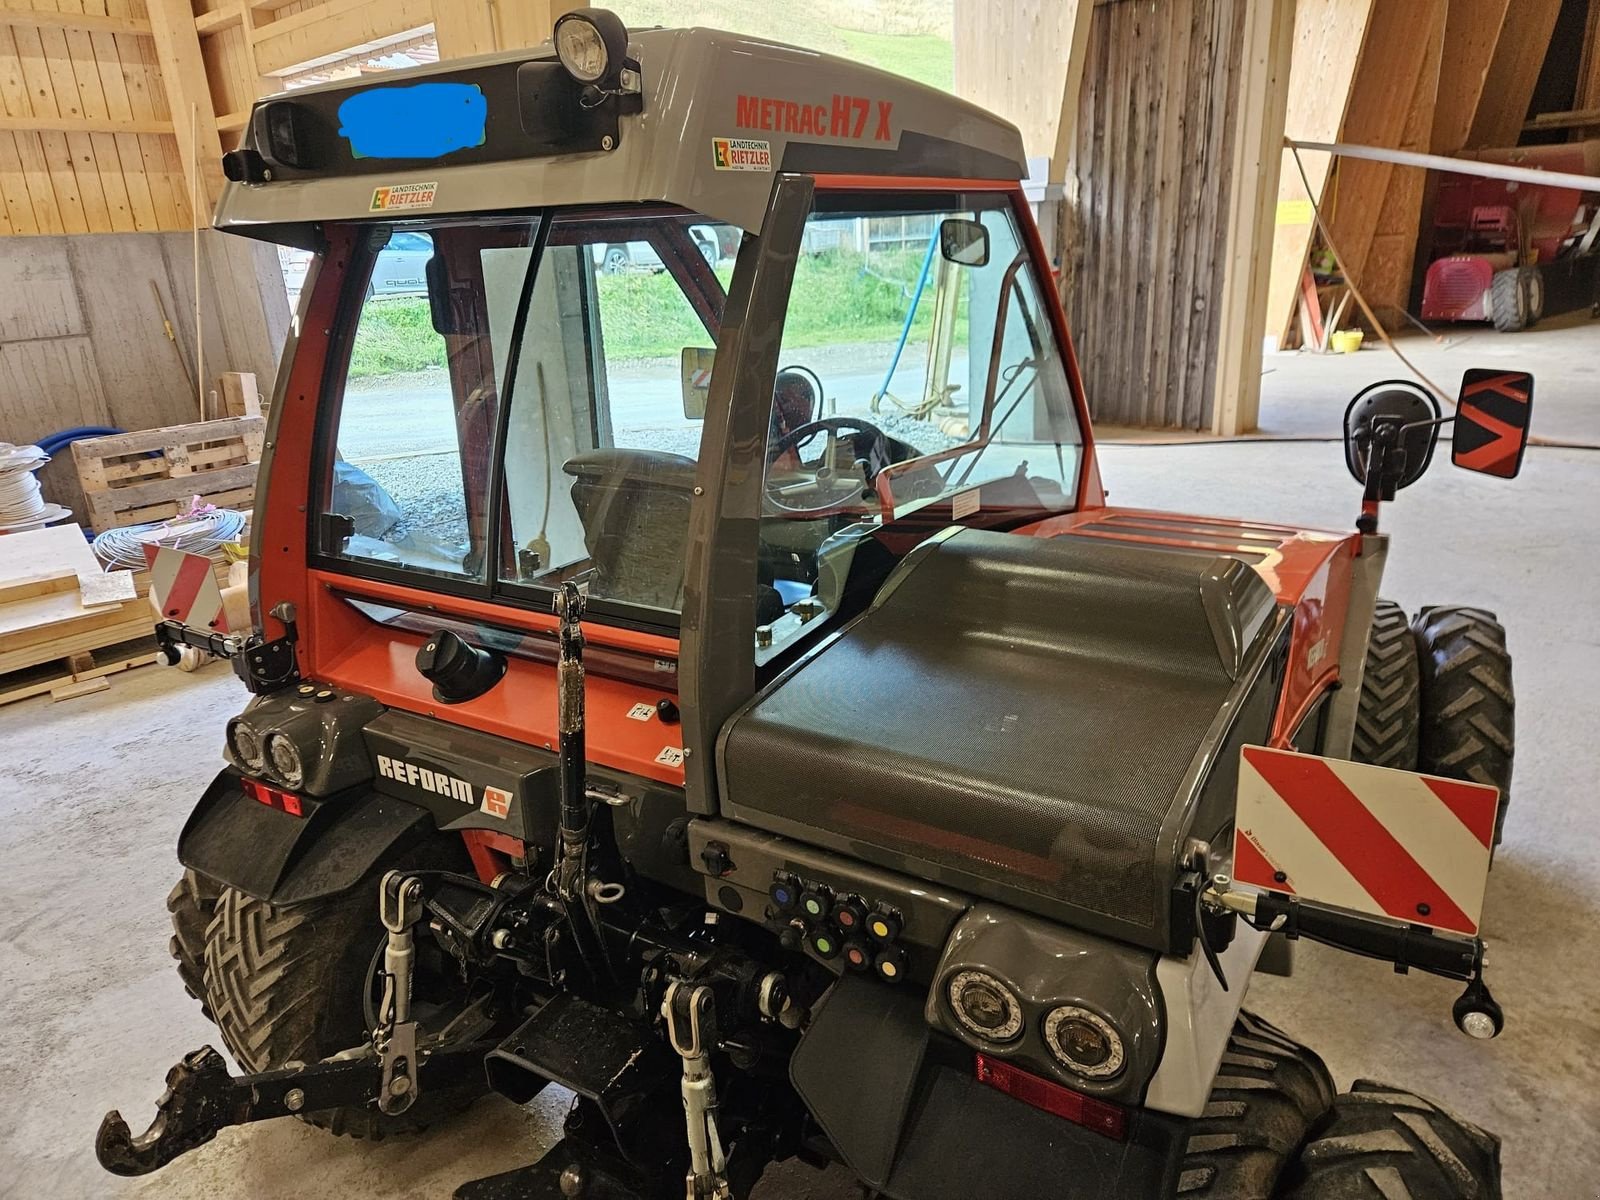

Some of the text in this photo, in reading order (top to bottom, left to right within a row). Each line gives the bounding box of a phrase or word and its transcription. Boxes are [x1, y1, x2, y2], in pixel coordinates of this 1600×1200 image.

[875, 101, 893, 142] X
[730, 140, 768, 150] LANDTECHNIK
[731, 150, 770, 166] RIETZLER
[392, 183, 435, 193] LANDTECHNIK
[389, 191, 433, 205] RIETZLER
[377, 754, 475, 805] REFORM
